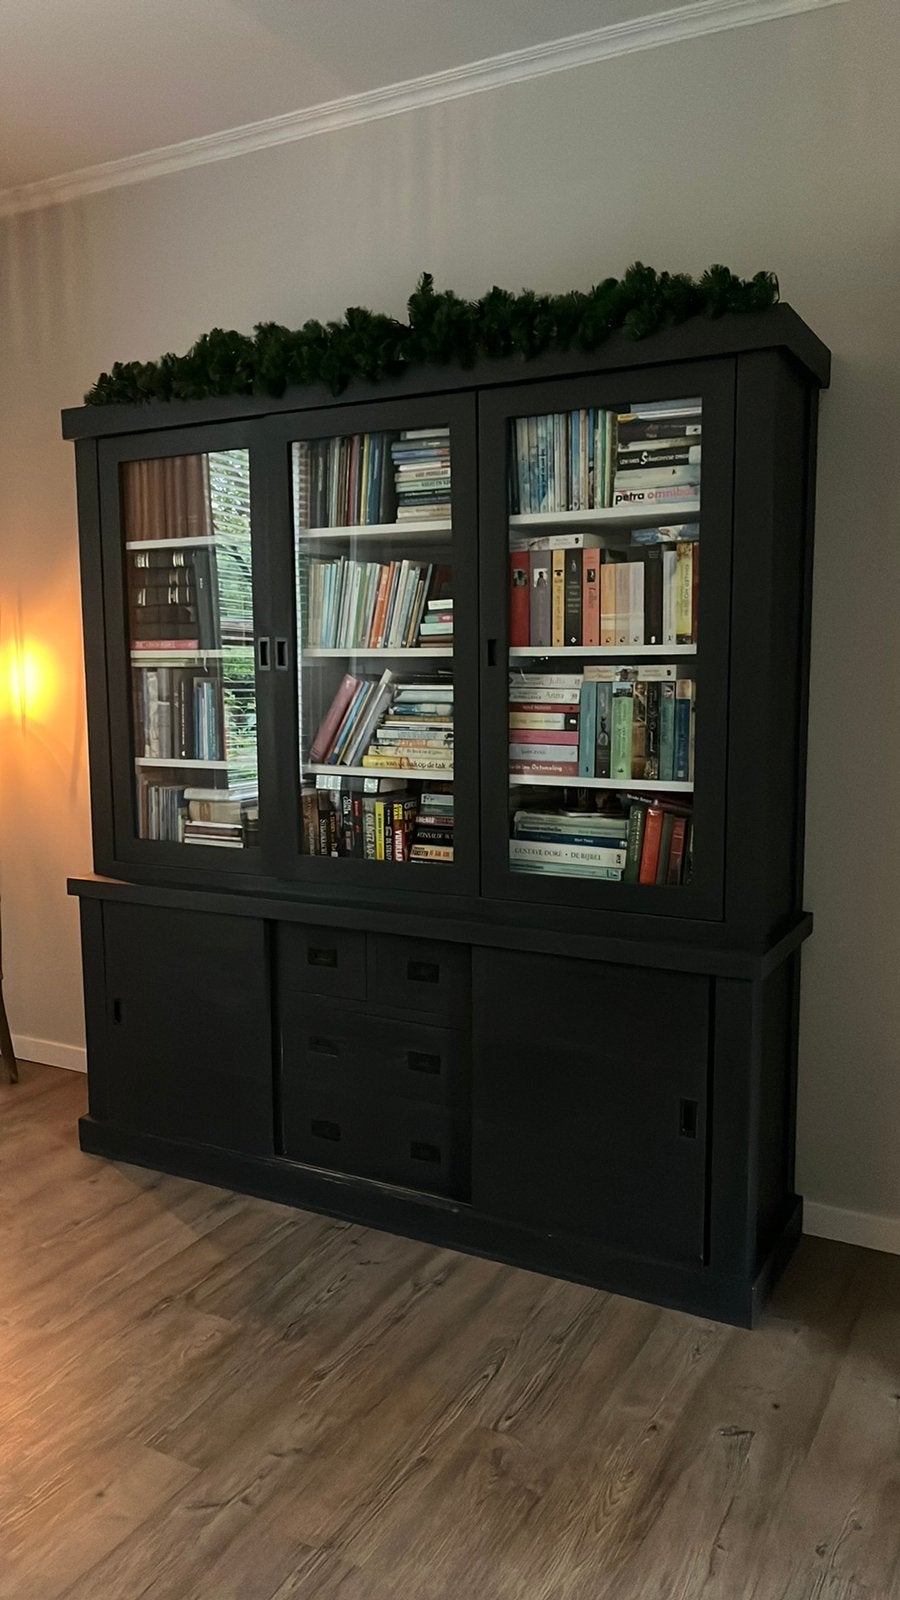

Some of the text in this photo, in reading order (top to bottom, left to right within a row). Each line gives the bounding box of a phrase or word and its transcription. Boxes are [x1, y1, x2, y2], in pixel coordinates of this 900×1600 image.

[615, 489, 645, 505] petra
[427, 760, 435, 768] de
[435, 761, 446, 769] tak
[514, 847, 543, 857] GUSTAVE
